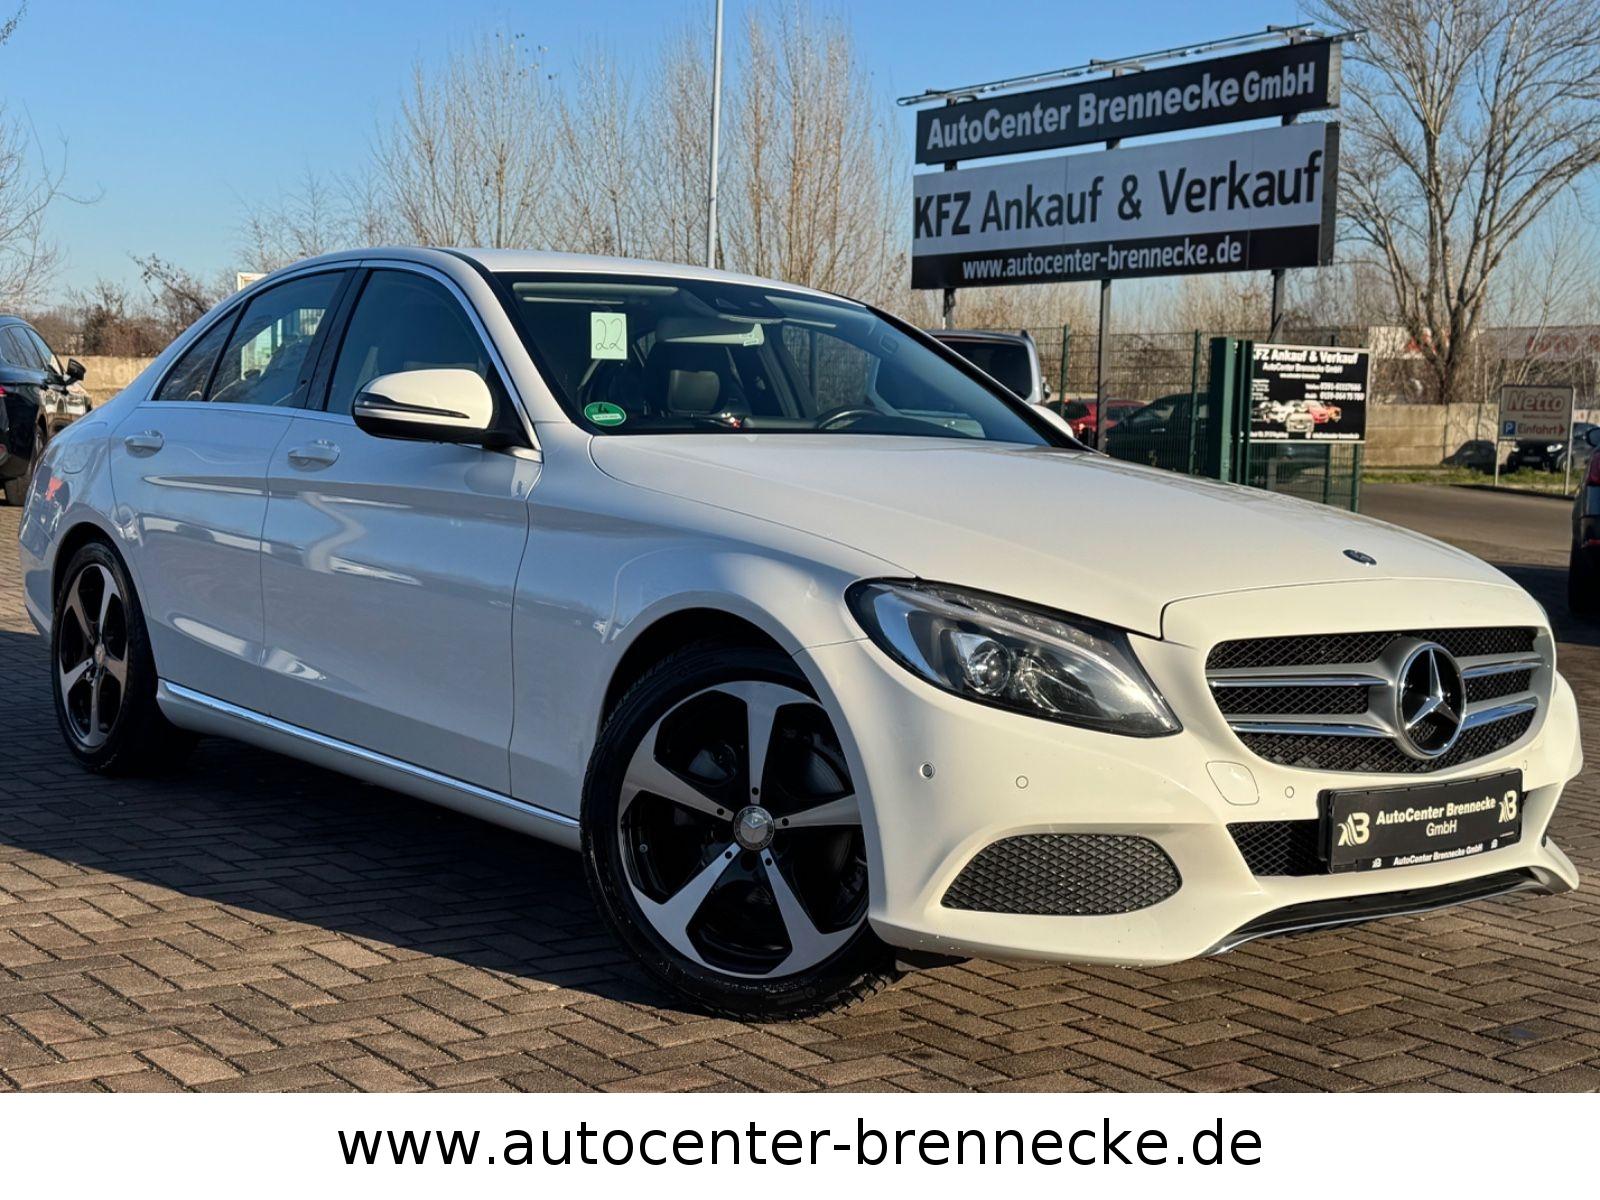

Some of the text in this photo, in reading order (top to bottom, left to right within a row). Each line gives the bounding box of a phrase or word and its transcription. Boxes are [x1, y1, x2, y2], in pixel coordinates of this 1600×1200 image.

[926, 61, 1316, 150] AutoCenter Brennecke GmbH
[914, 150, 1323, 239] KFZ Ankauf & Verkauf
[962, 235, 1242, 280] www.autocenter-brennecke.de
[595, 317, 624, 352] 22
[1271, 349, 1308, 362] Ankauf
[1309, 351, 1318, 363] &
[1319, 351, 1359, 364] Verkauf
[1507, 389, 1564, 412] Netto
[1518, 422, 1556, 435] Einfahrt
[1375, 807, 1445, 826] AutoCenter
[1446, 796, 1496, 816] Brennecke
[1426, 819, 1458, 837] GmbH
[1393, 853, 1432, 866] AutoCenter
[1433, 848, 1465, 861] Brennecke
[1466, 843, 1483, 855] GmbH
